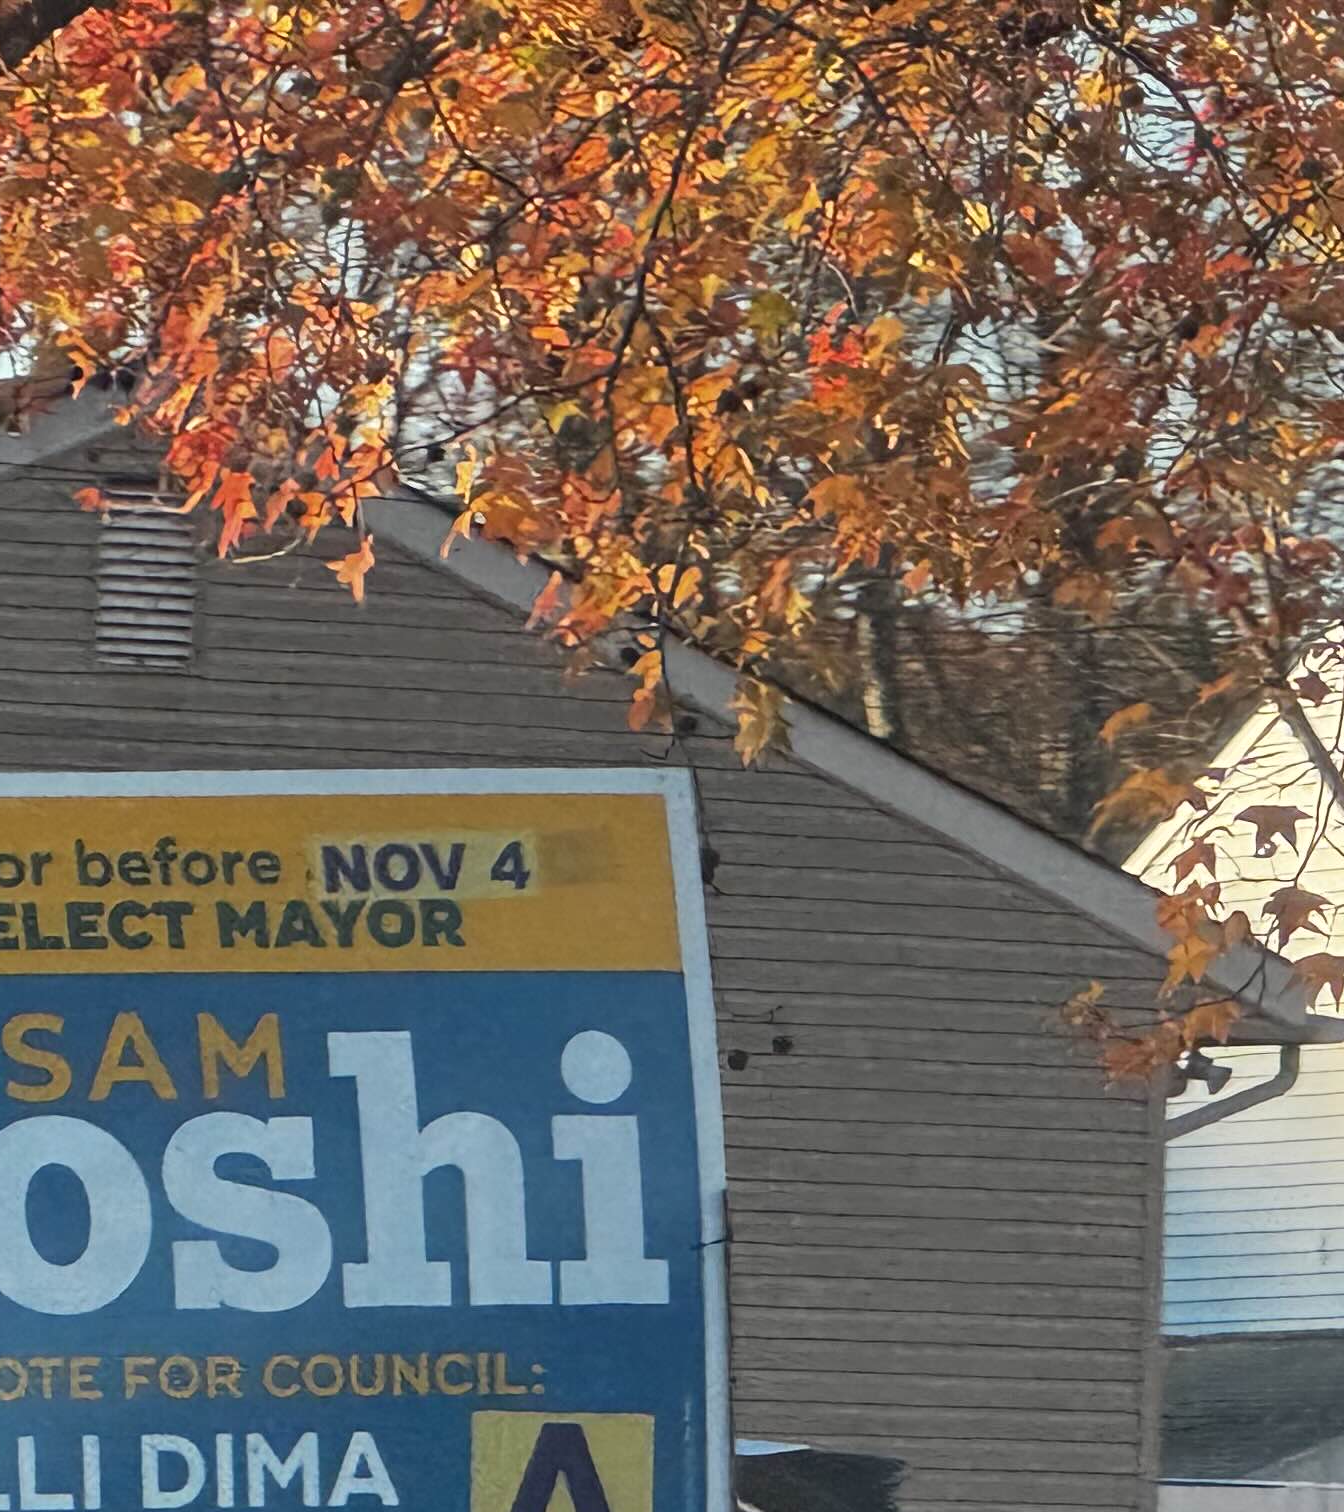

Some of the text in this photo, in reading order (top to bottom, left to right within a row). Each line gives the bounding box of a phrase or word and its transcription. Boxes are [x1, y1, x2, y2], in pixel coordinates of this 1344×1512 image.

[75, 835, 281, 887] before
[321, 842, 467, 893] NOV
[490, 840, 531, 890] 4
[215, 899, 467, 949] MAYOR
[1, 1012, 287, 1103] SAM
[120, 1354, 246, 1399] FOR
[262, 1352, 547, 1397] COUNCIL:
[140, 1431, 399, 1510] DIMA
